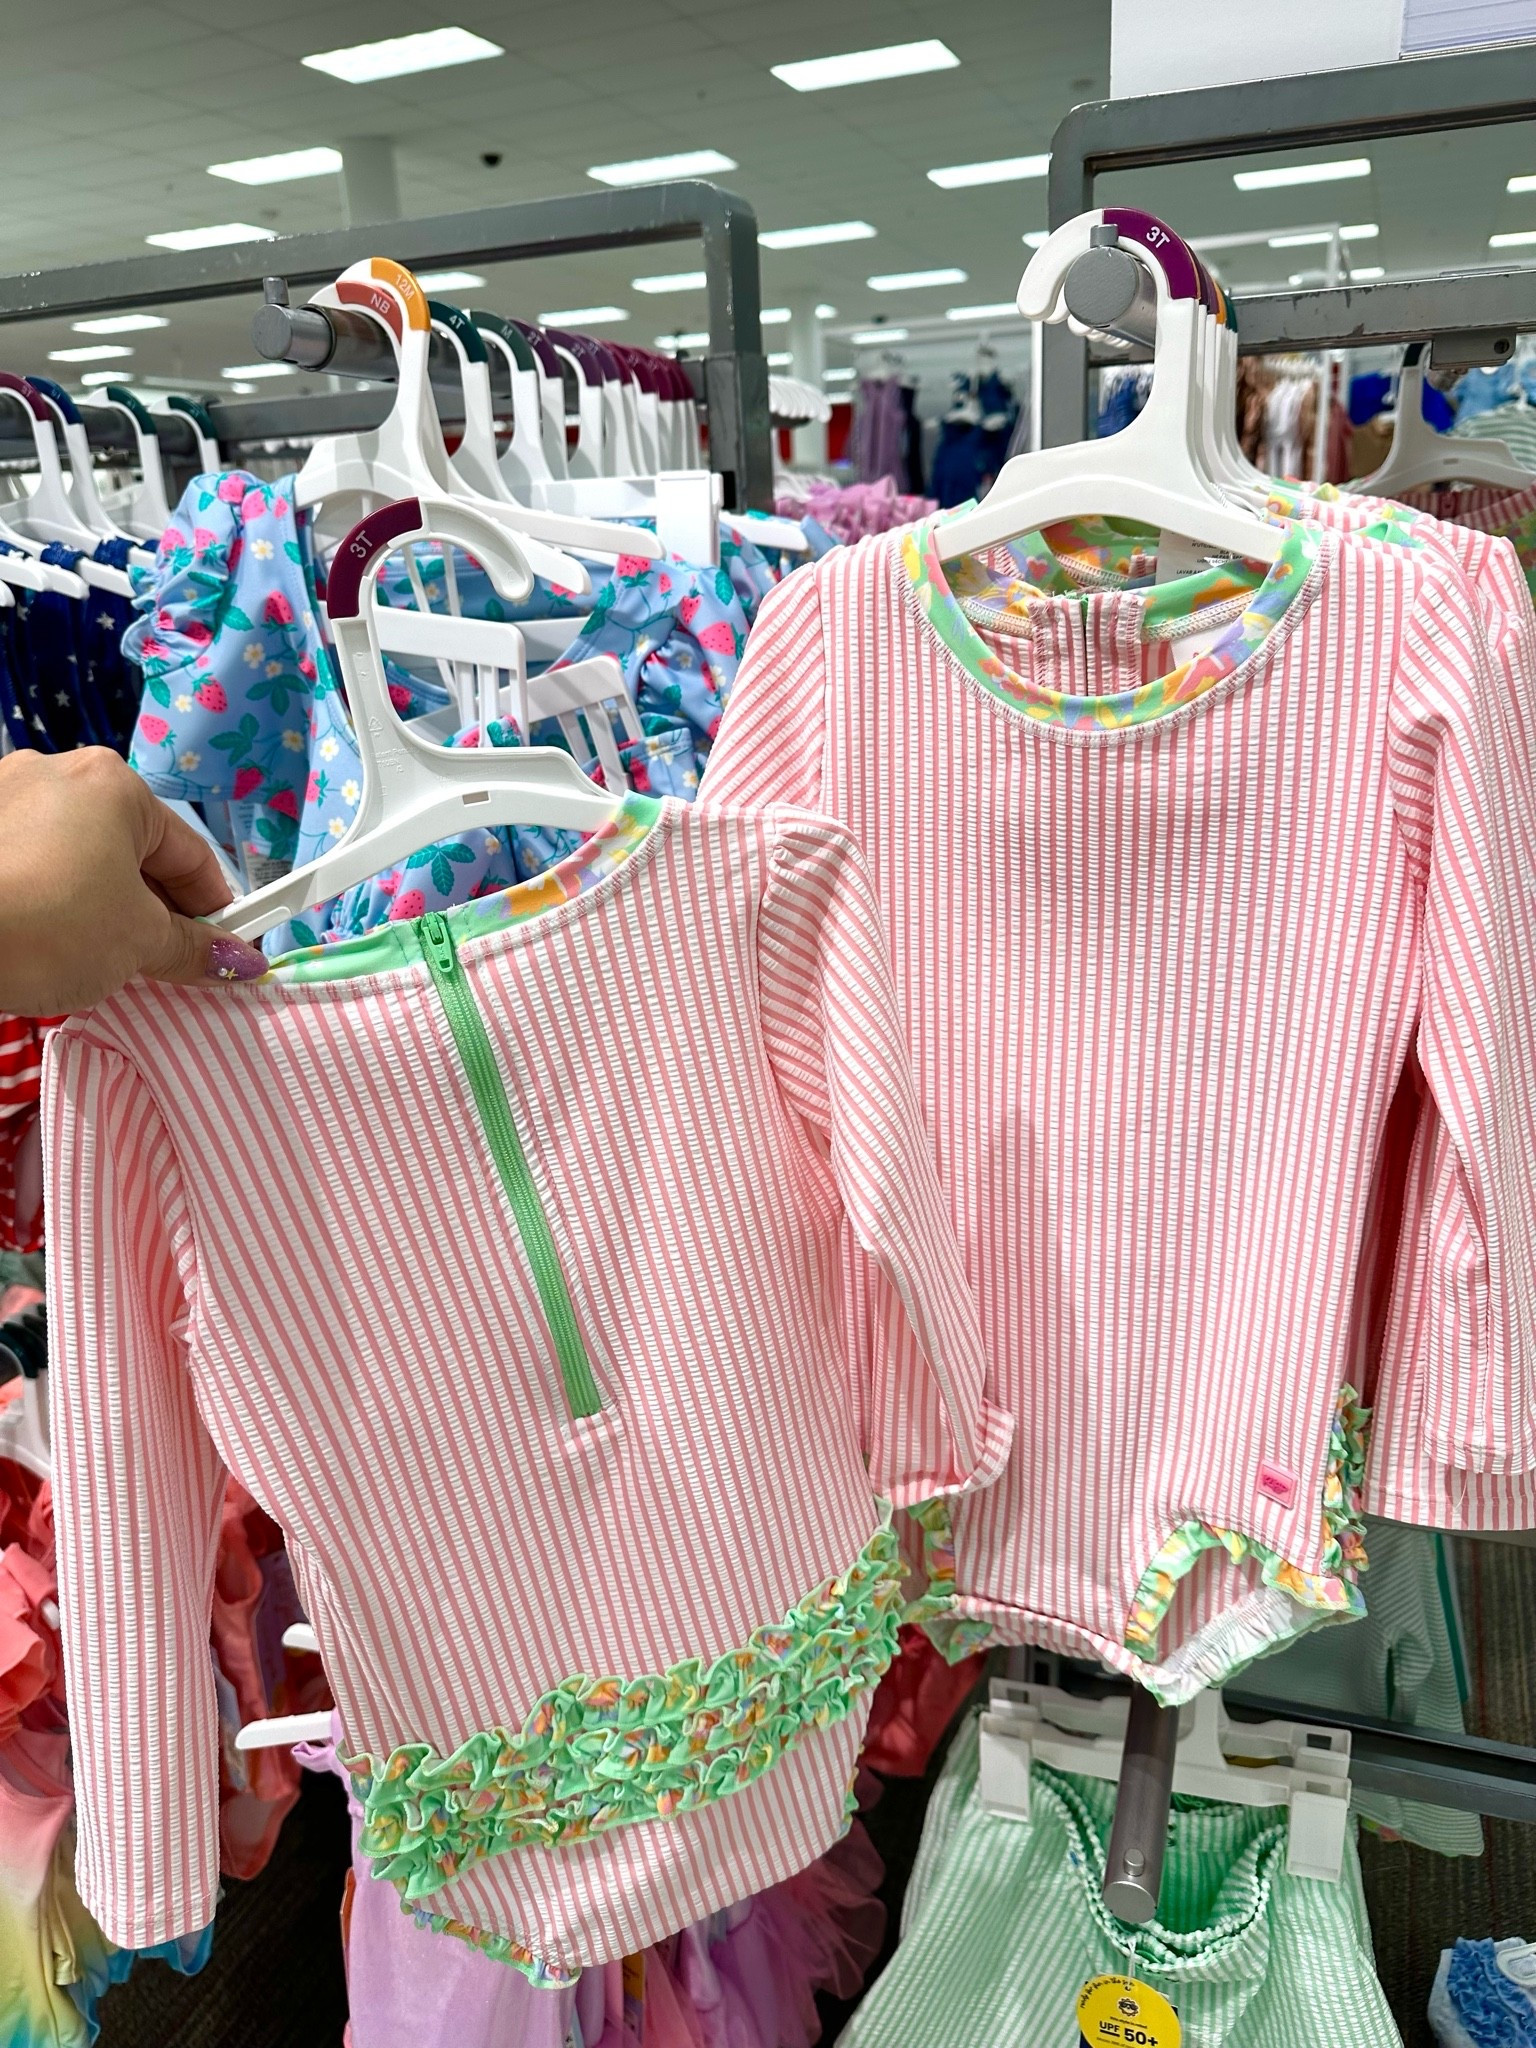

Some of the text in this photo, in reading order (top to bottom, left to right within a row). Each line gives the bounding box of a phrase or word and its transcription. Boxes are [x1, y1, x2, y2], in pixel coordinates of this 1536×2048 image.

[1145, 225, 1171, 249] 3T
[395, 273, 416, 301] 12M
[370, 292, 391, 315] NB
[448, 314, 466, 331] 4T
[349, 529, 373, 559] 3T
[1099, 2020, 1120, 2033] UPF
[1124, 2027, 1159, 2047] 50+
